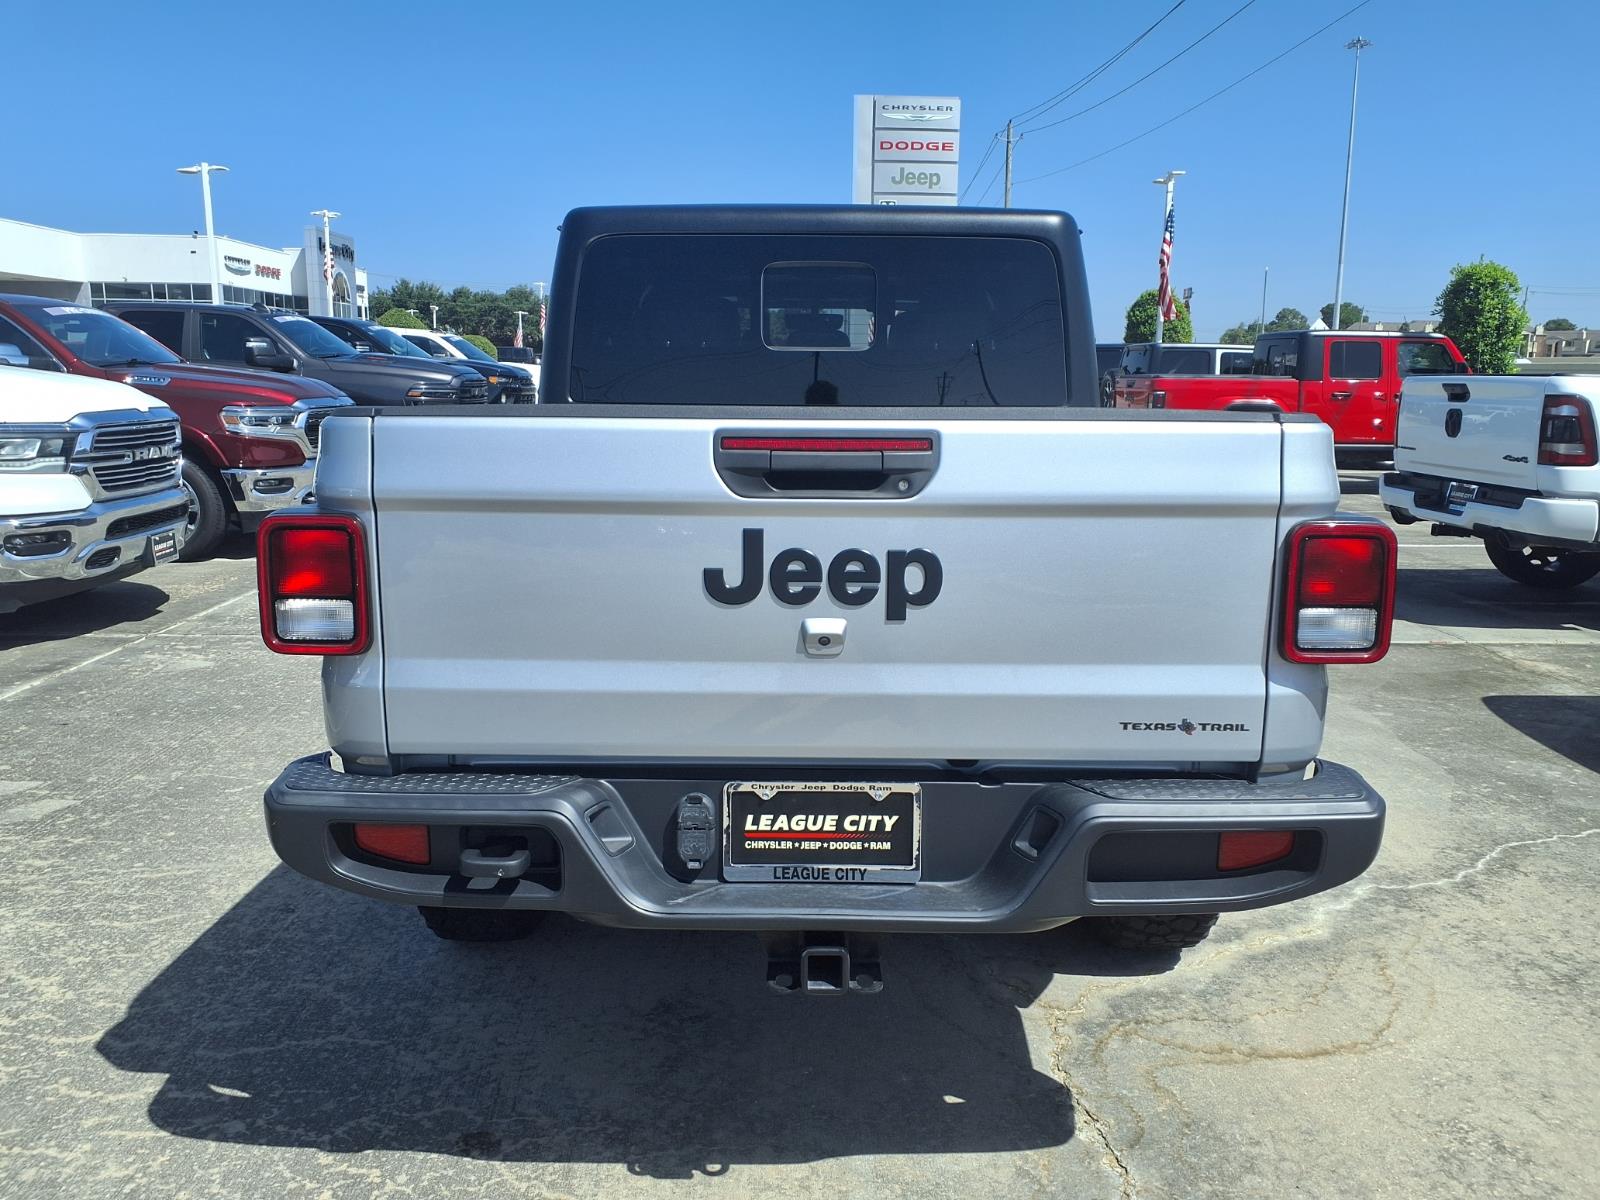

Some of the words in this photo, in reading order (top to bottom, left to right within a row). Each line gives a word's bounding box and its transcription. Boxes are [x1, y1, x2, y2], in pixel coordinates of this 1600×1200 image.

[880, 140, 954, 151] DODGE
[891, 167, 941, 189] Jeep
[703, 528, 944, 621] Jeep
[1119, 721, 1177, 731] TEXAS
[1198, 722, 1250, 732] TRAIL
[751, 783, 795, 791] Chrysler
[801, 783, 826, 791] Jeep
[833, 784, 865, 792] Dodge
[744, 814, 840, 832] LEAGUE
[843, 815, 900, 832] CITY
[745, 840, 793, 849] CHRYSLER
[800, 841, 822, 850] JEEP
[829, 841, 862, 850] DODGE
[870, 841, 891, 850] RAM
[773, 867, 831, 881] LEAGUE
[835, 867, 868, 881] CITY
